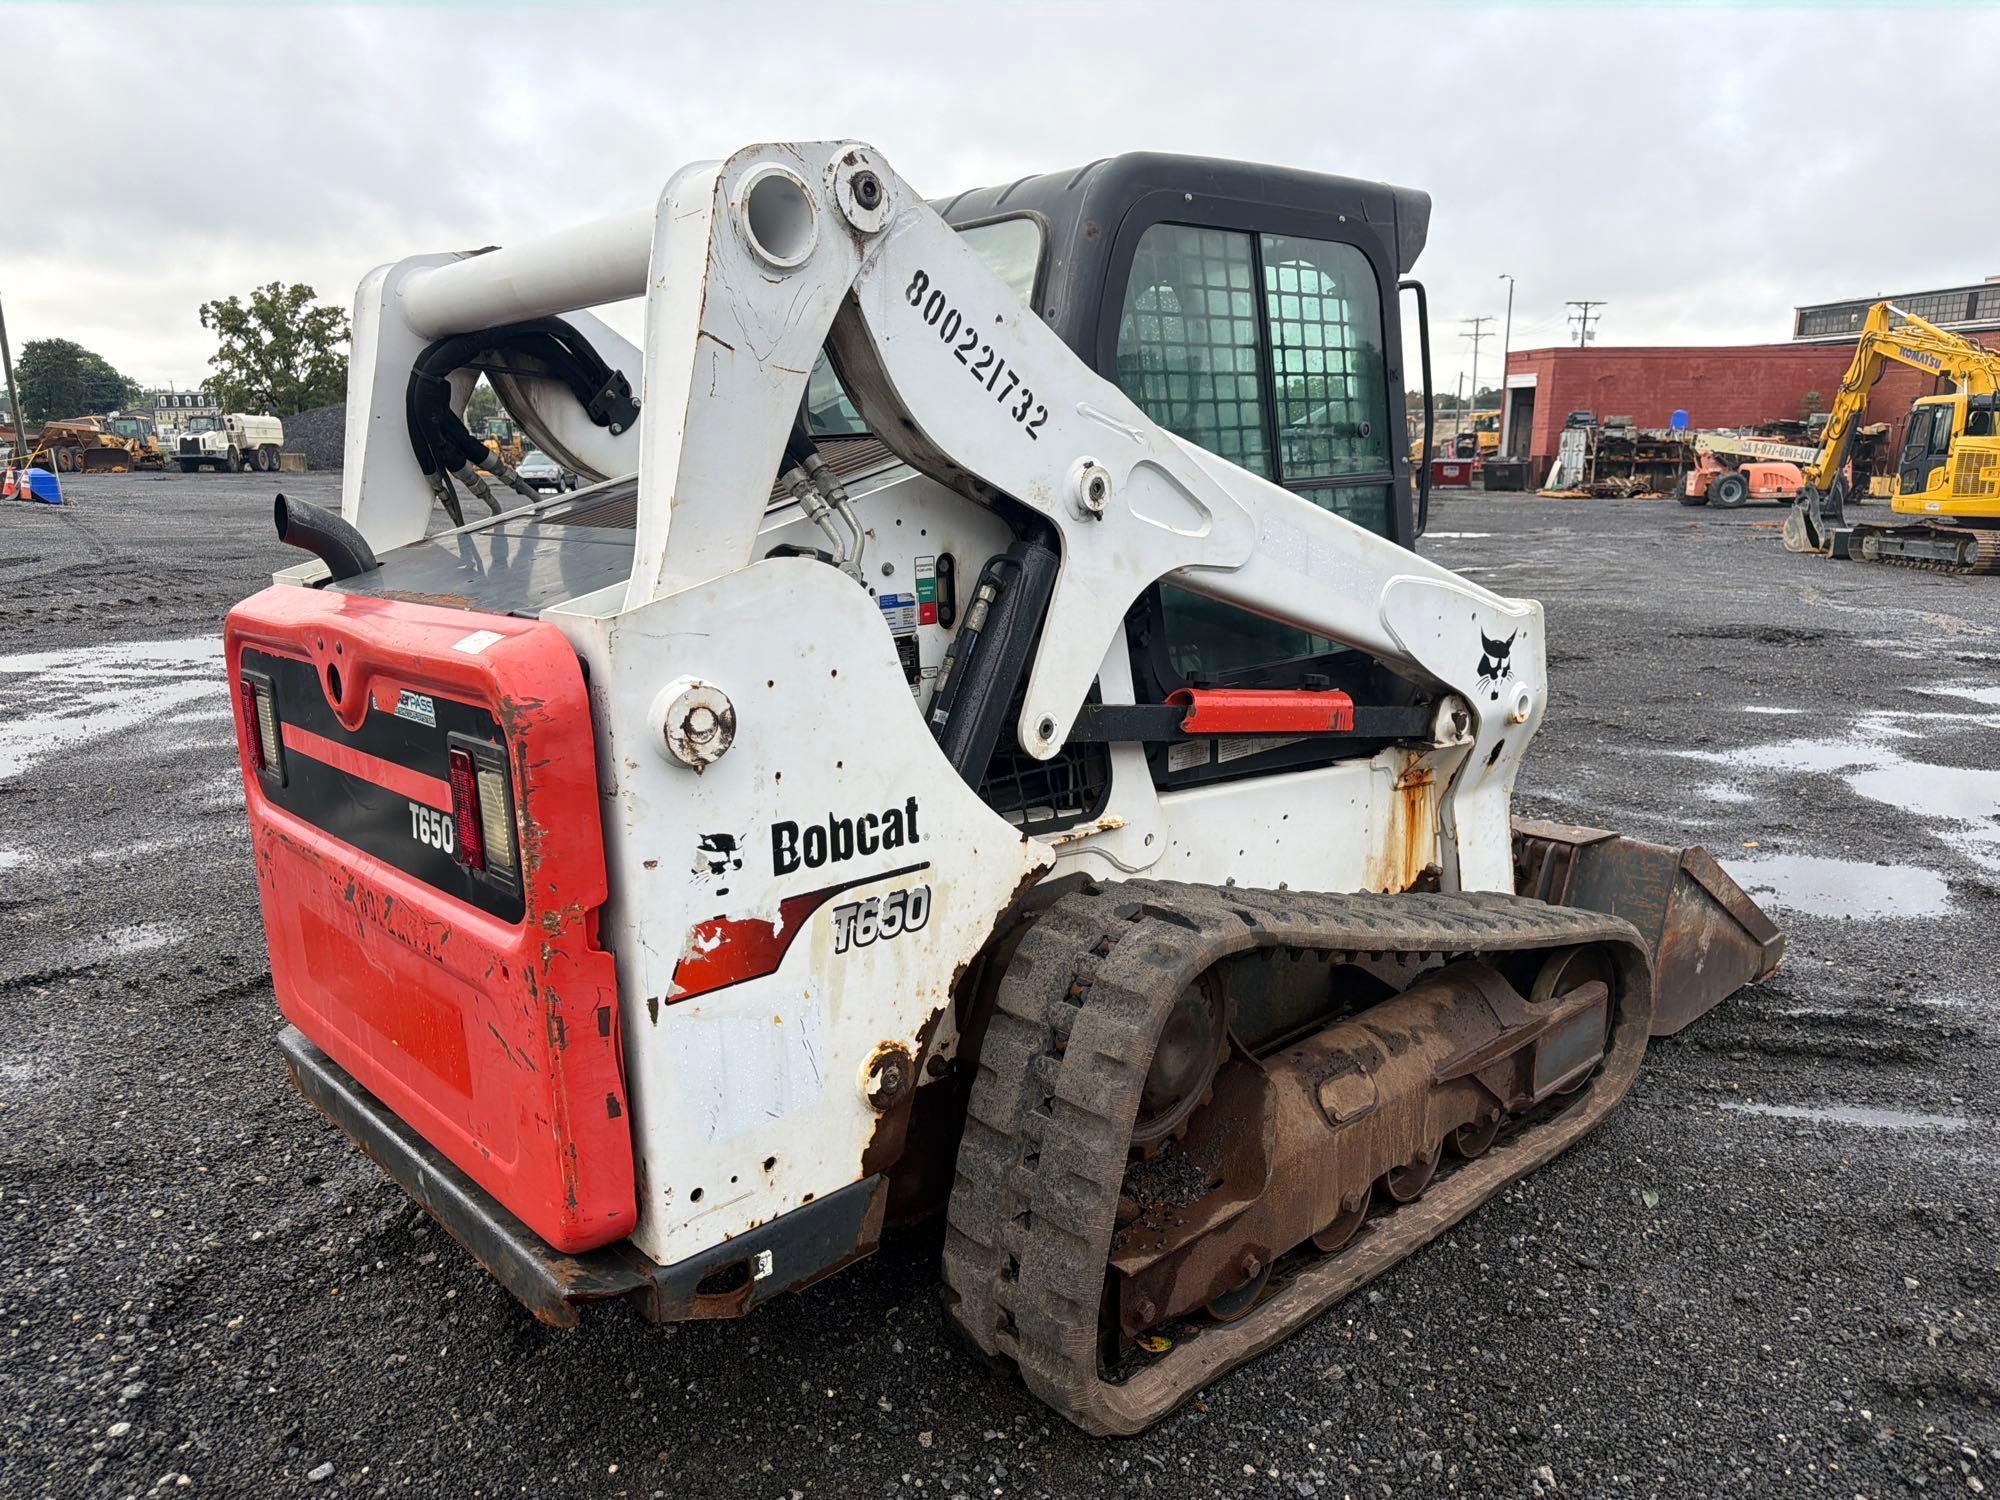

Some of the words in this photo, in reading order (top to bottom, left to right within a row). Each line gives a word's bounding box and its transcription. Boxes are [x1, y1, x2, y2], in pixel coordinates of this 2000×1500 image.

[905, 269, 1048, 441] 800221732
[1899, 345, 1942, 369] KOMATSU
[409, 801, 454, 853] T650
[771, 796, 920, 876] Bobcat
[832, 884, 931, 954] T650
